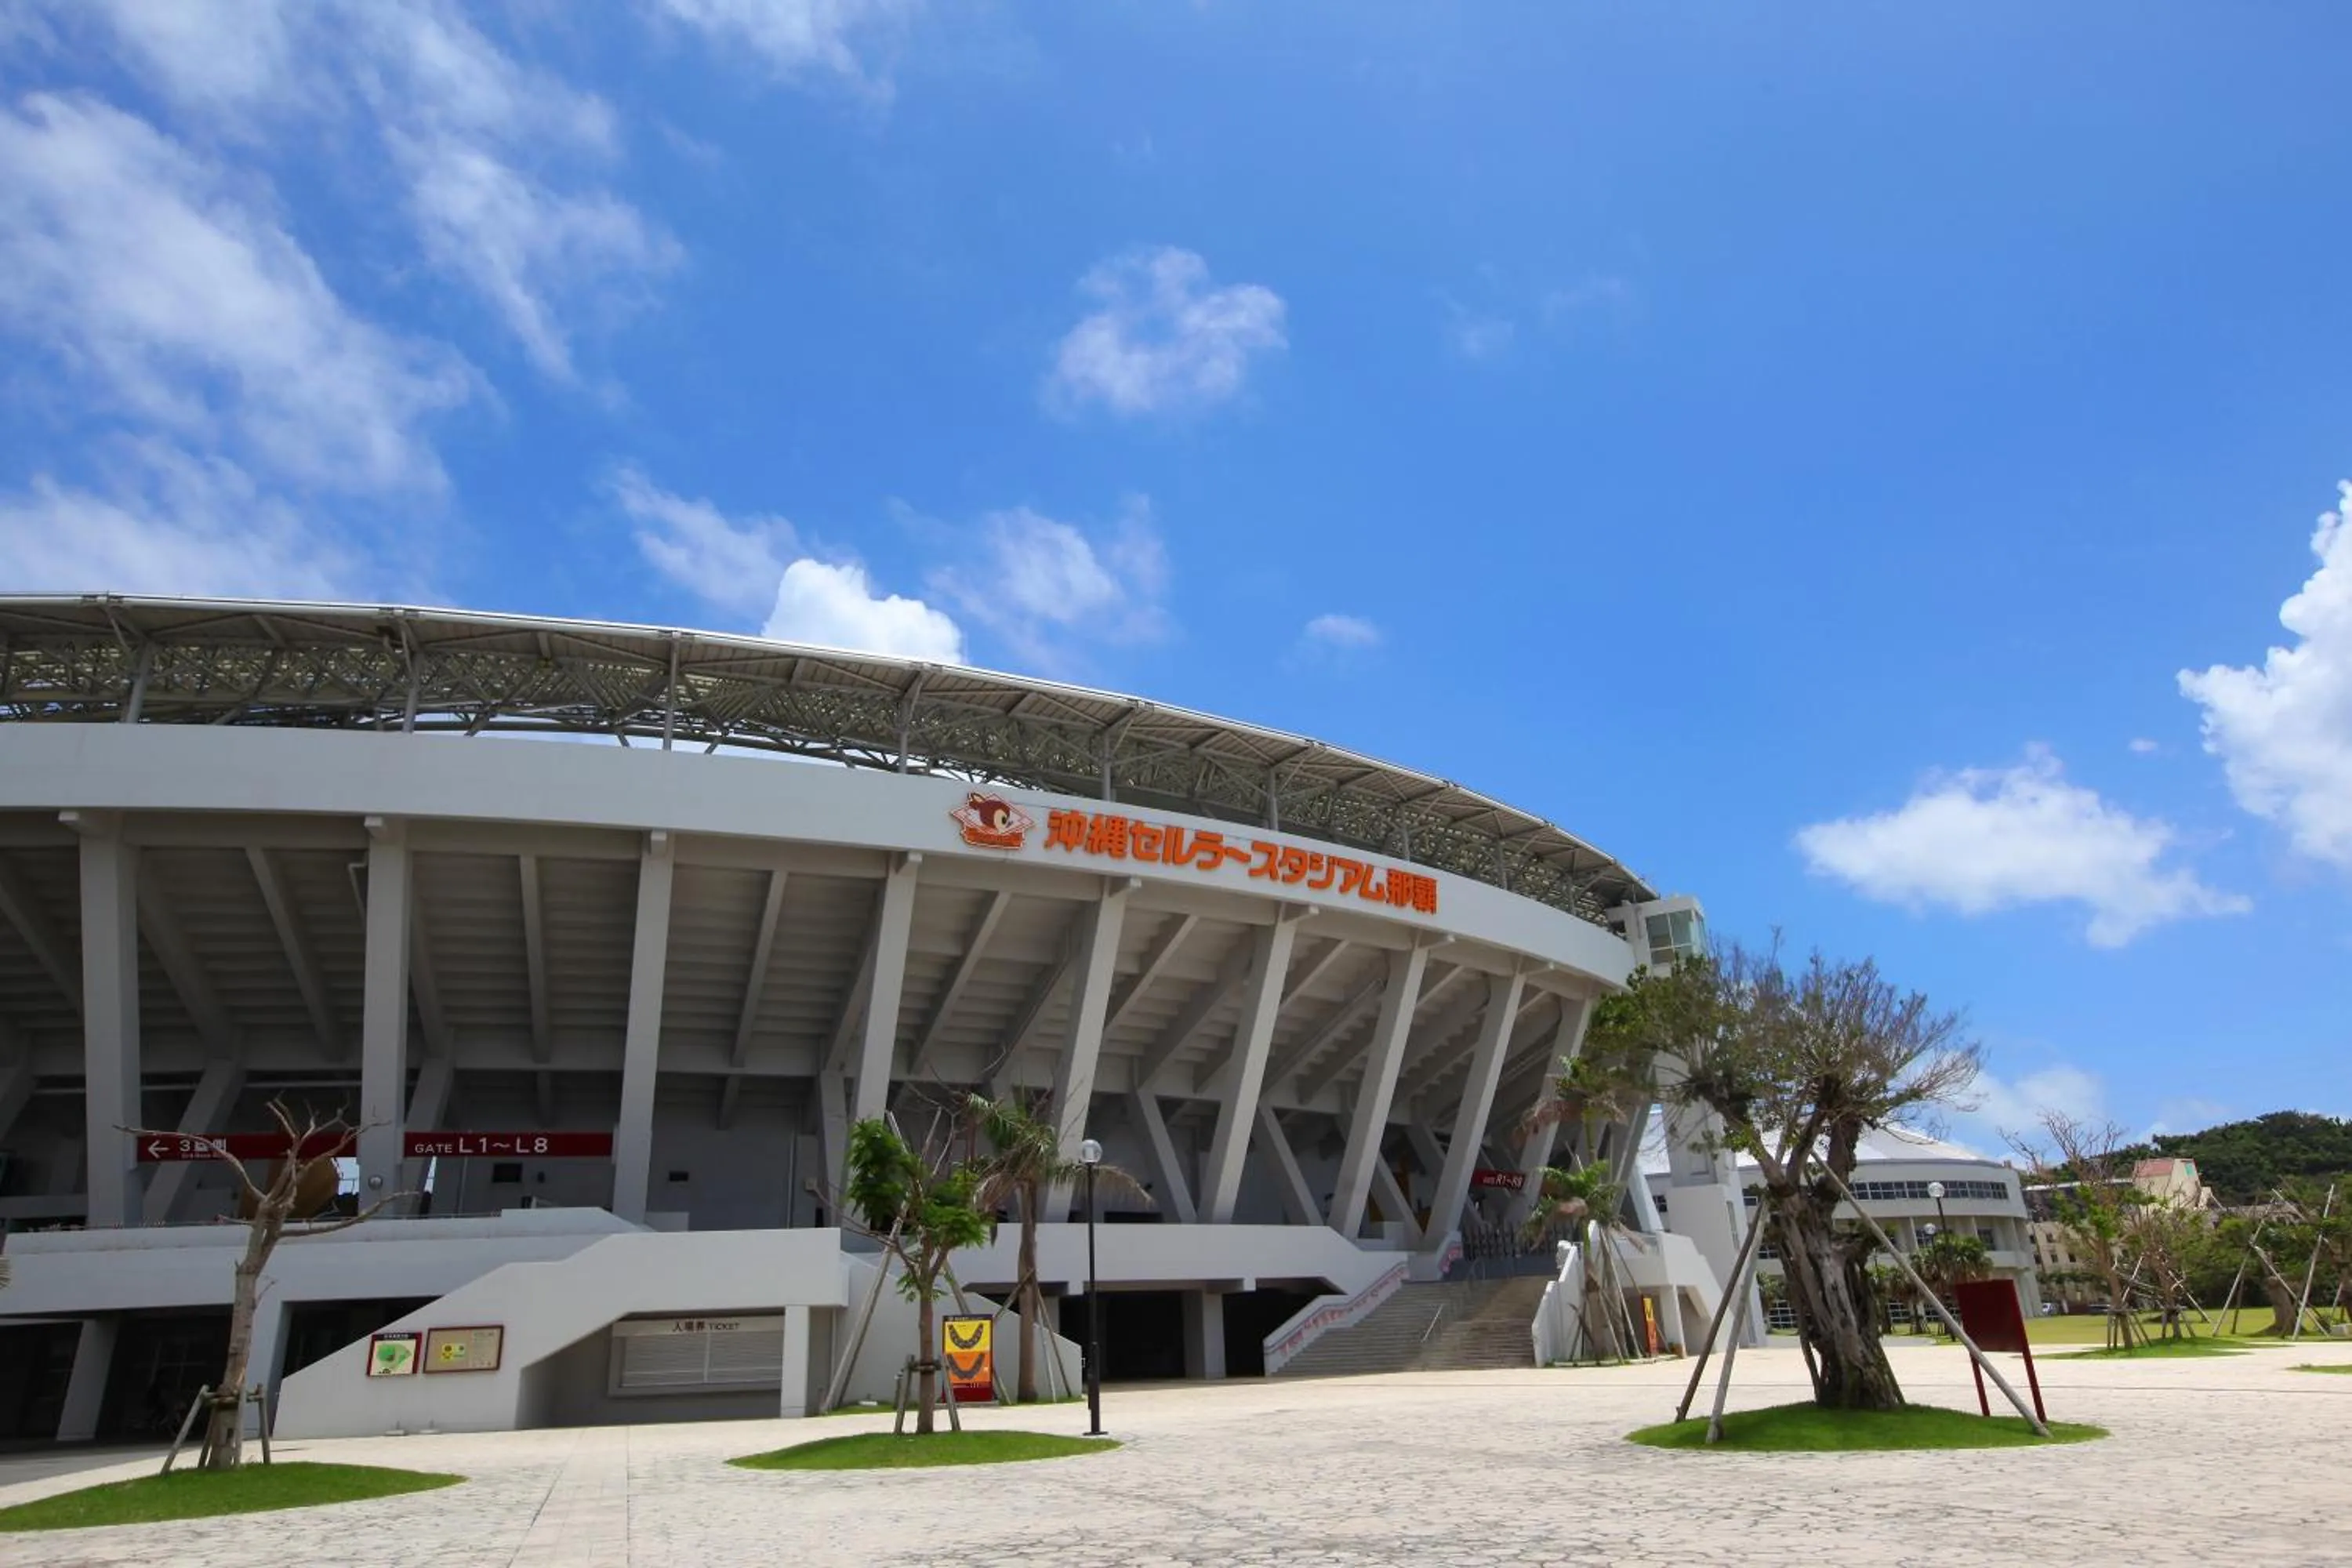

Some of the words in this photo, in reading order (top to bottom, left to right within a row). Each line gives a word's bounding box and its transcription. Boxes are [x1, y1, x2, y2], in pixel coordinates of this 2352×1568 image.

[1044, 809, 1437, 914] 沖縄セルラースタジアム那覇
[415, 1144, 452, 1153] GATE
